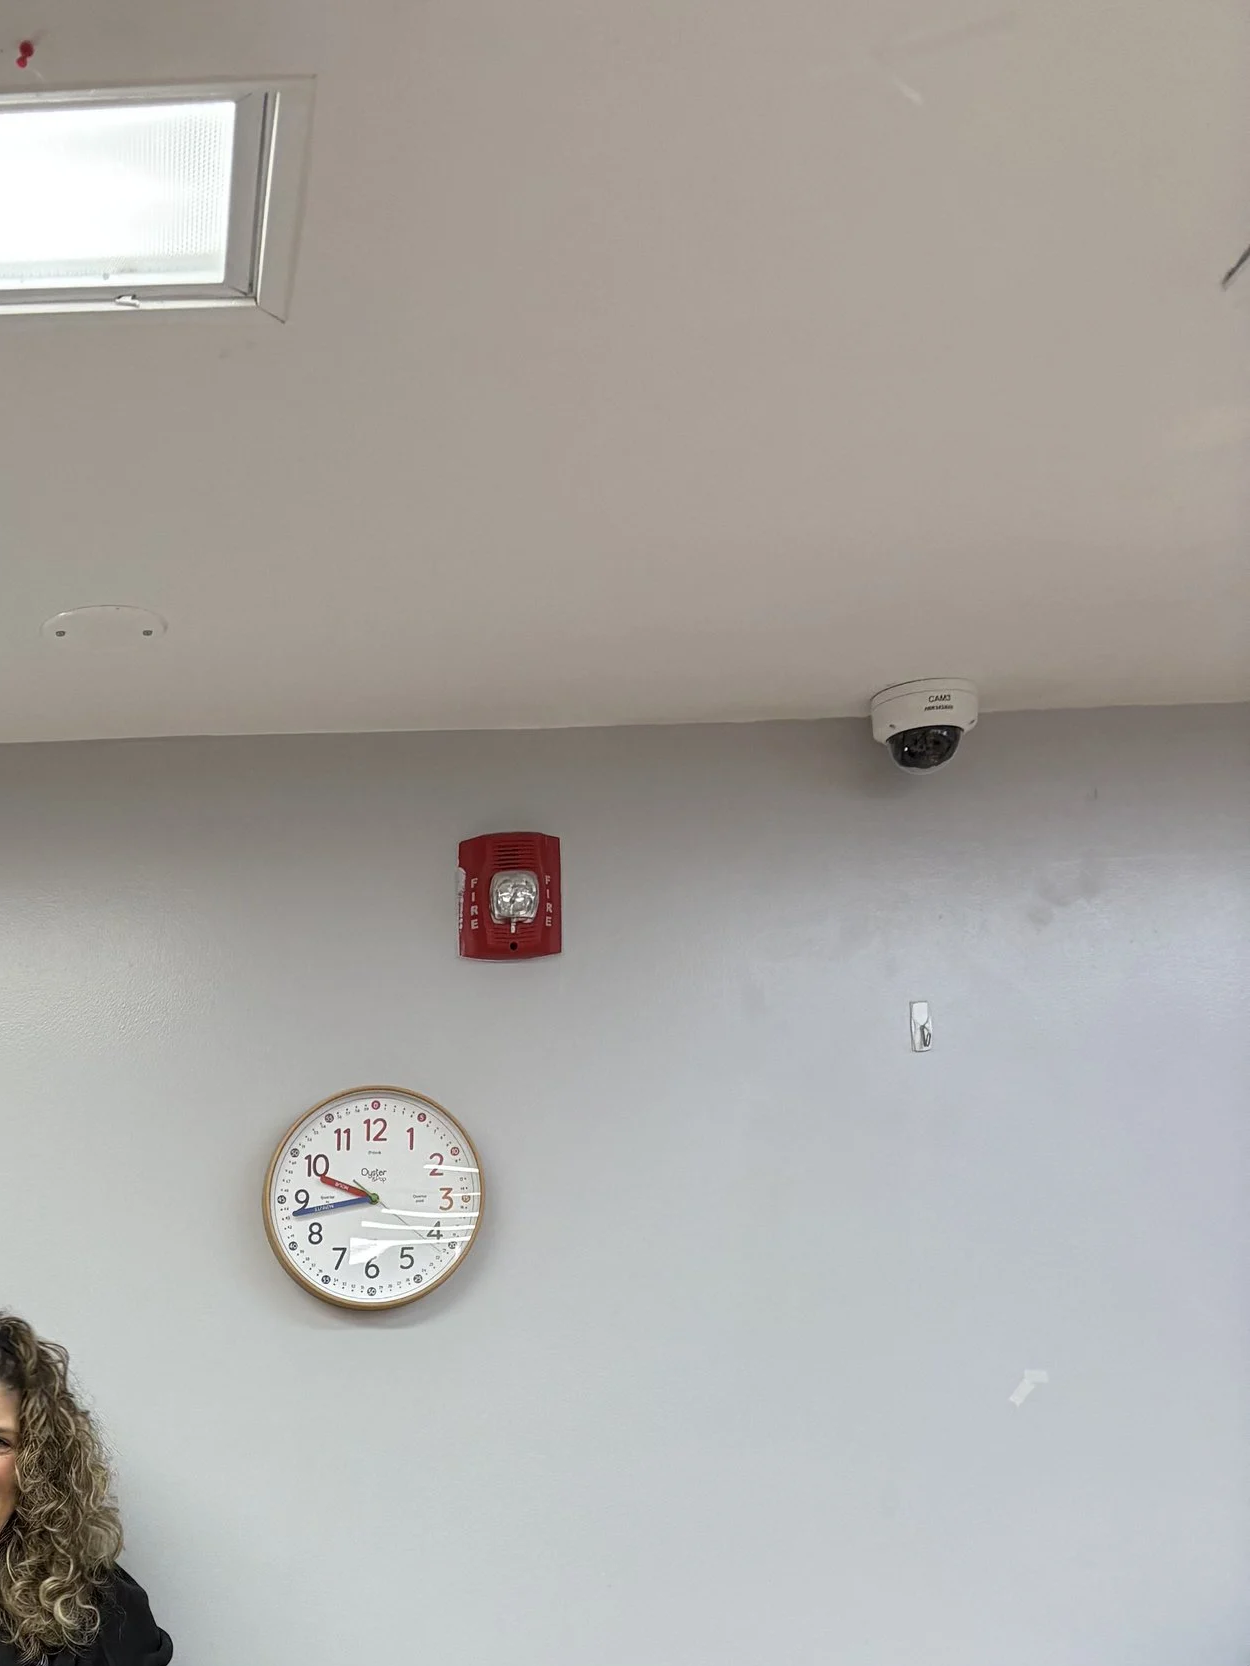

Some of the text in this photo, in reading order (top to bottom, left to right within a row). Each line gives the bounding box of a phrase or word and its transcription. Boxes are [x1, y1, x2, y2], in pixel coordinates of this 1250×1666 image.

[470, 877, 479, 930] FIRE
[545, 875, 553, 927] FIRE
[334, 1128, 351, 1151] 11
[363, 1118, 387, 1141] 12
[406, 1127, 414, 1150] 1
[305, 1154, 330, 1177] 10
[361, 1168, 387, 1179] Oyster
[429, 1153, 444, 1176] 2
[294, 1189, 310, 1210] 9
[439, 1187, 454, 1211] 3
[308, 1222, 323, 1245] 8
[426, 1220, 443, 1240] 4
[332, 1247, 347, 1271] 7
[364, 1256, 380, 1279] 6
[399, 1246, 415, 1269] 5
